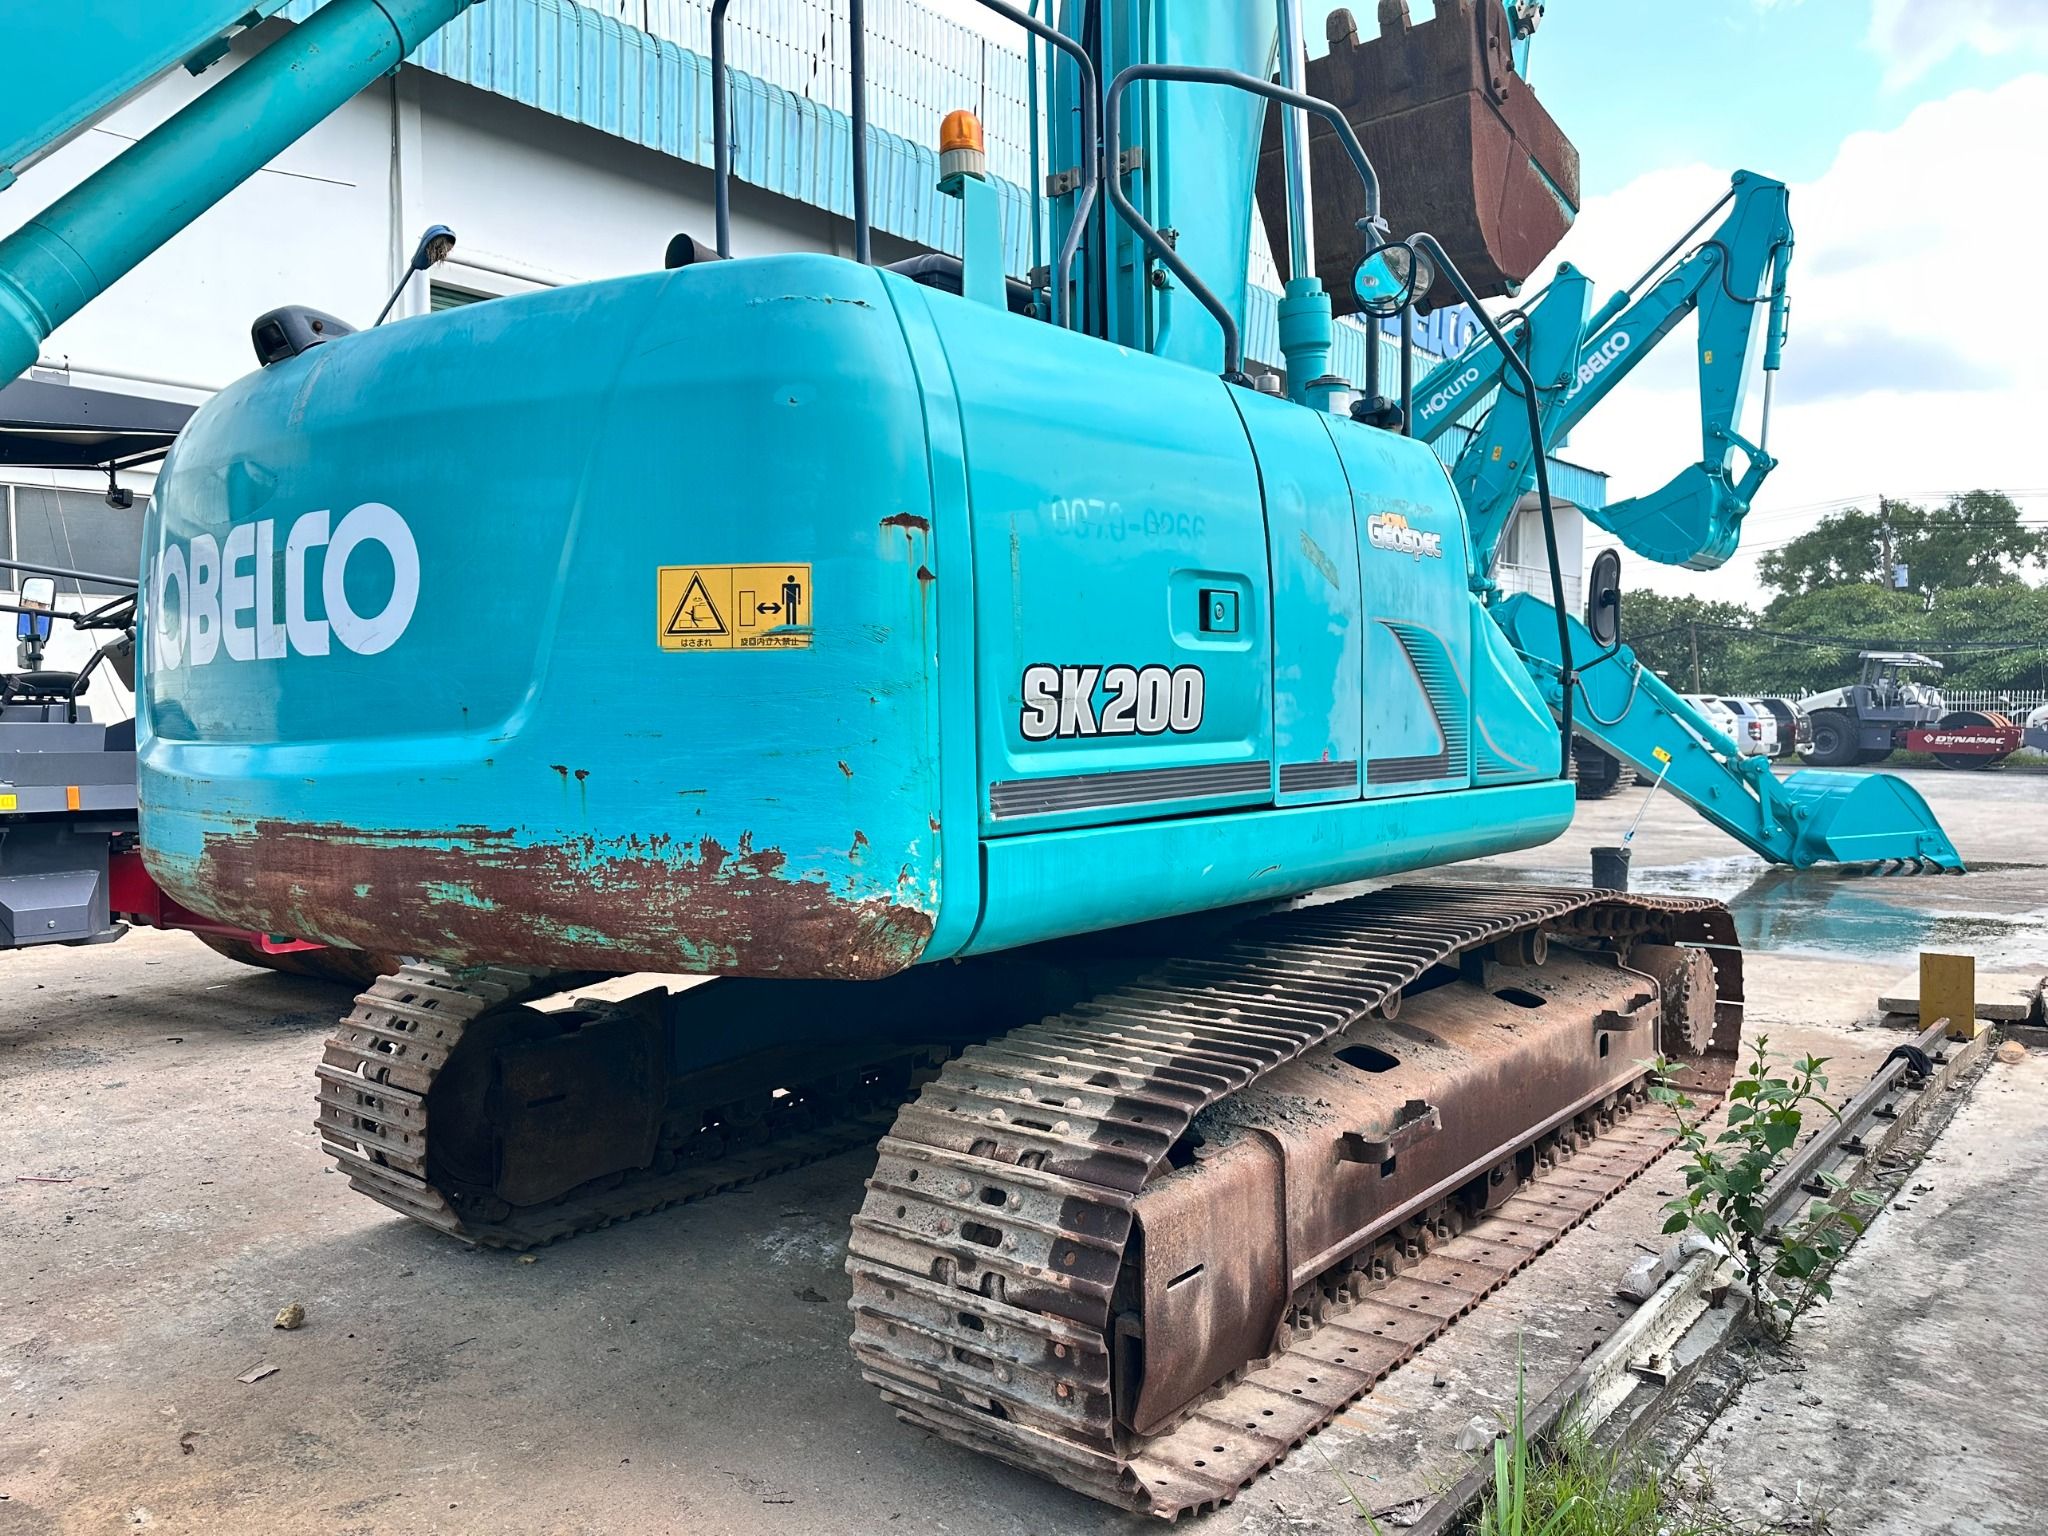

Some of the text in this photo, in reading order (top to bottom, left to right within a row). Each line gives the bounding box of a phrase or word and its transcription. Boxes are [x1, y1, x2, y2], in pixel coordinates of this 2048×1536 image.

[1420, 367, 1479, 420] HOKUTO
[680, 638, 712, 647] はさまれ
[1020, 663, 1205, 742] SK200
[1934, 735, 2006, 745] DYNAPAC
